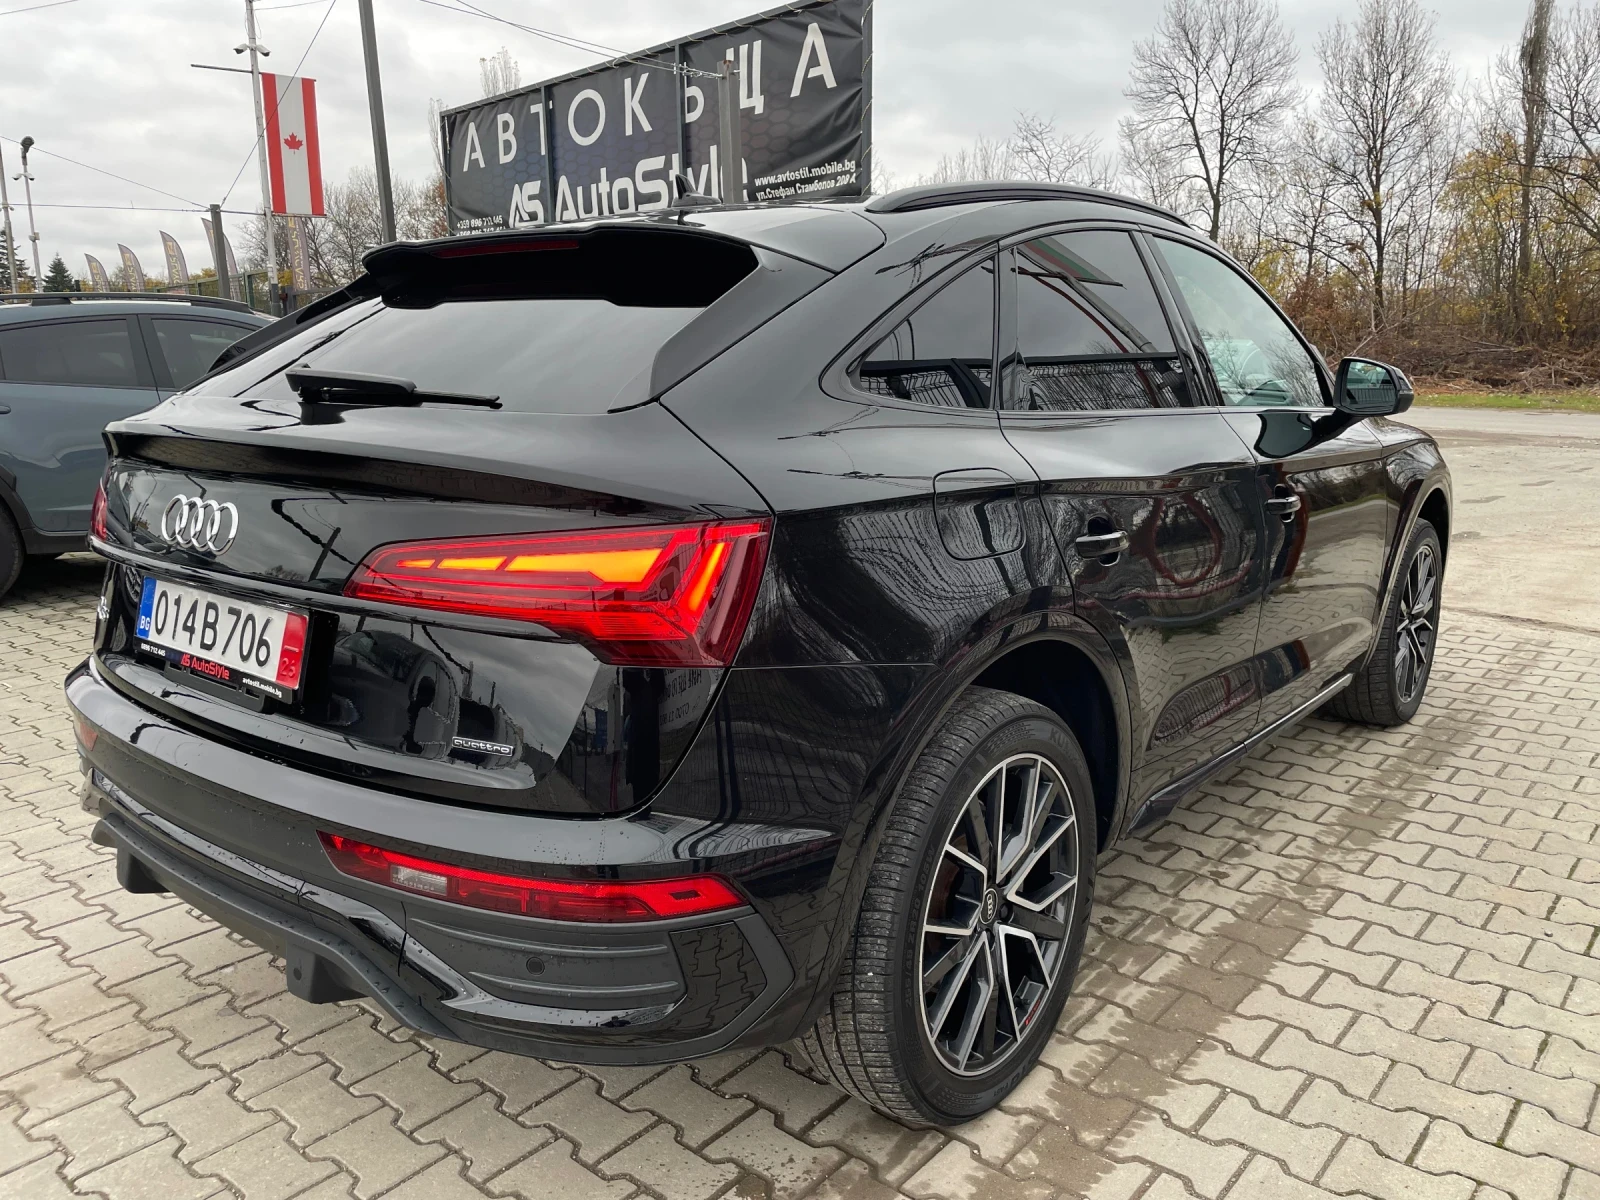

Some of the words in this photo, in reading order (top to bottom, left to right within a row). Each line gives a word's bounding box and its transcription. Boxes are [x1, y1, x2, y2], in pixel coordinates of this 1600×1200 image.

[754, 160, 856, 187] www.avtostil.mobile.bg
[457, 219, 470, 229] +359
[140, 615, 150, 630] BG
[155, 589, 272, 667] 014B706
[191, 656, 230, 680] AutoStyle
[242, 677, 282, 698] avtostil.mobile.bg
[454, 739, 510, 754] quattro
